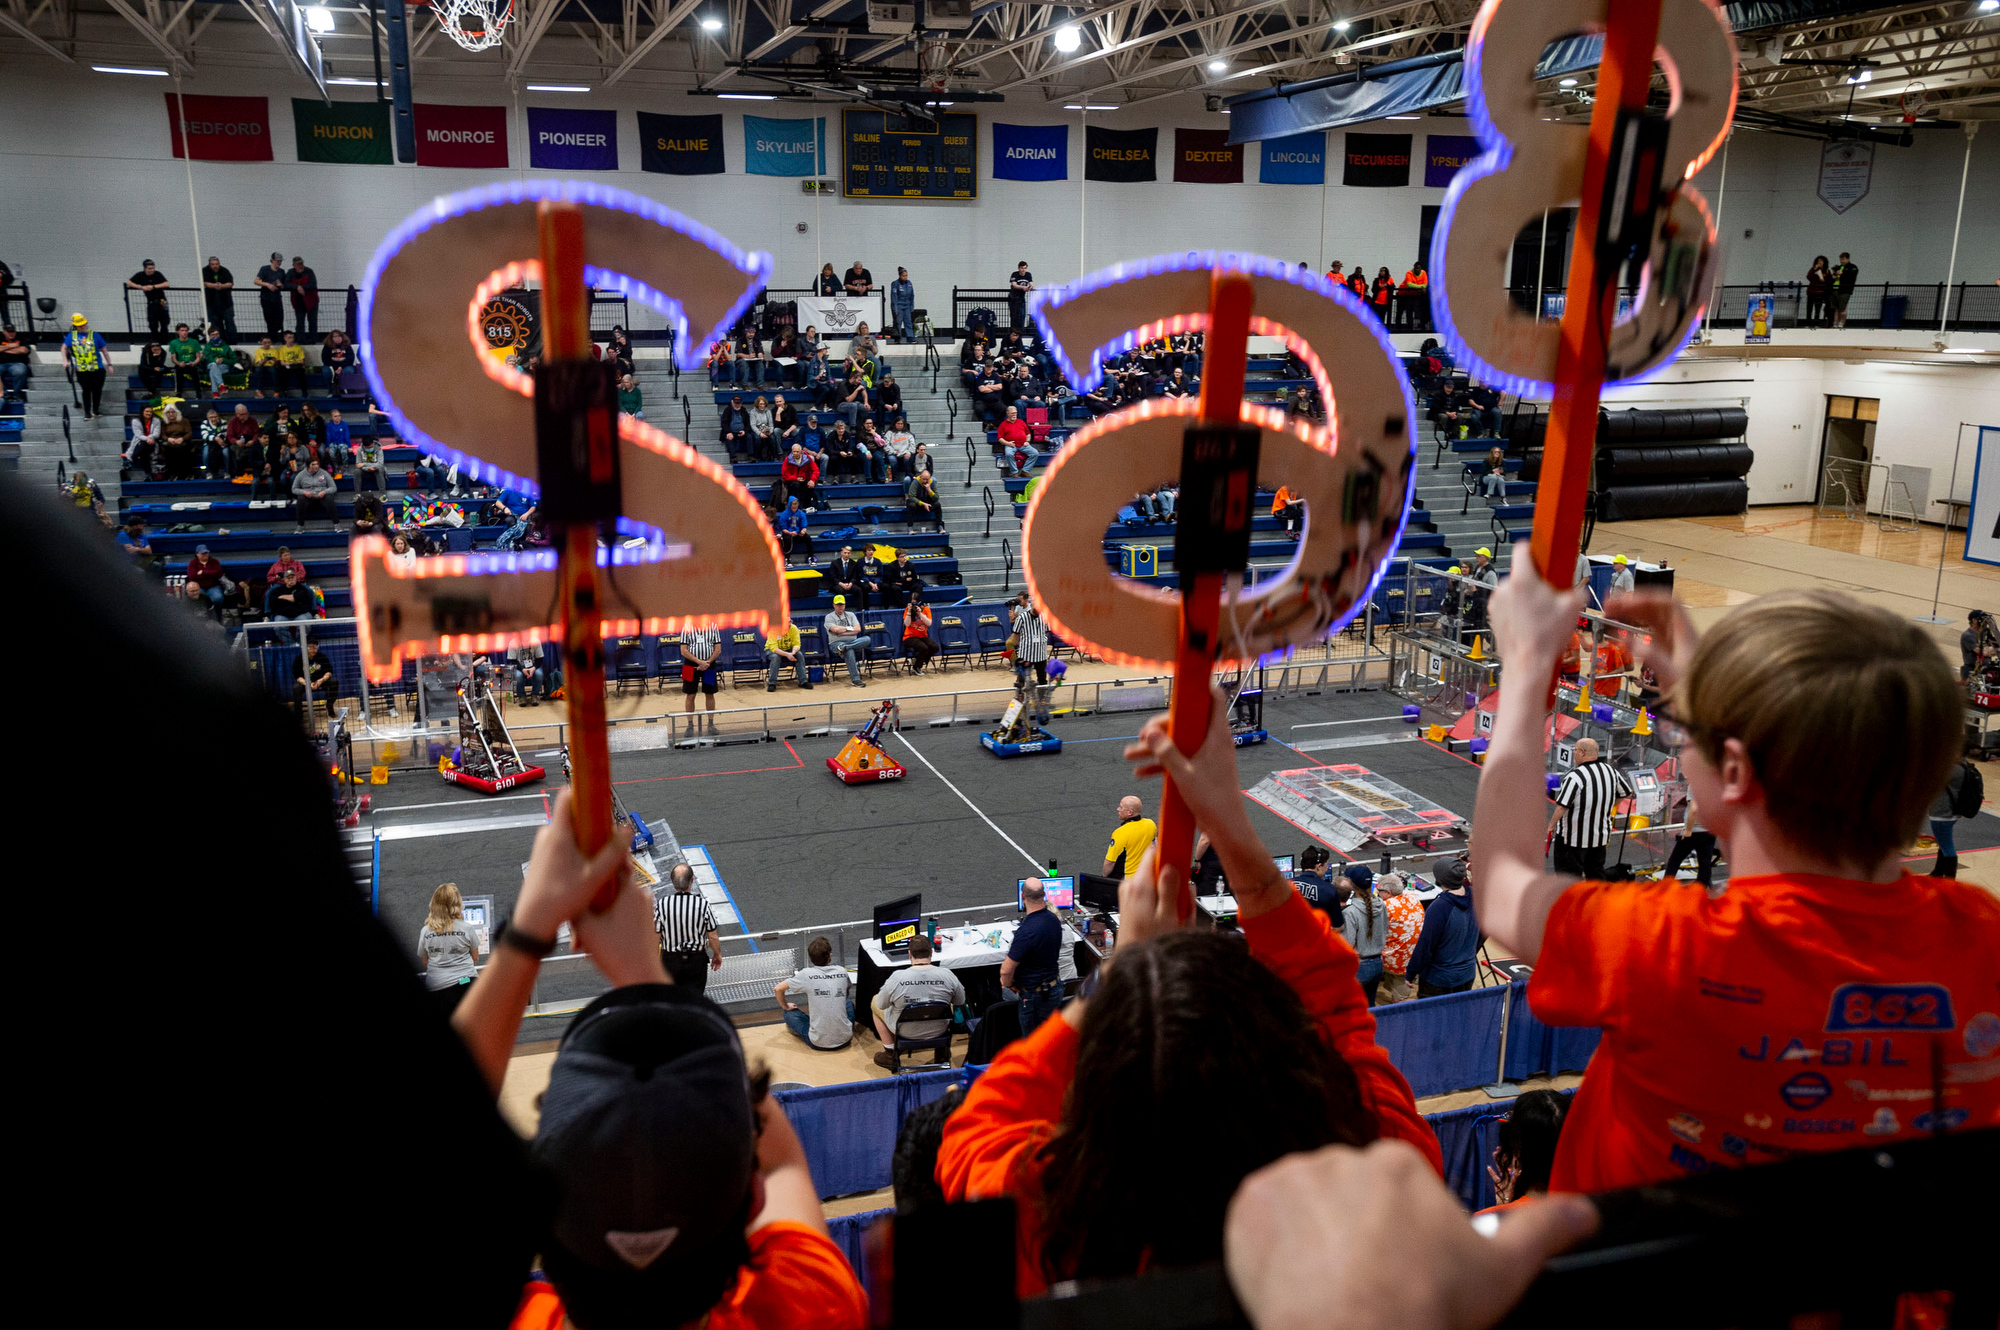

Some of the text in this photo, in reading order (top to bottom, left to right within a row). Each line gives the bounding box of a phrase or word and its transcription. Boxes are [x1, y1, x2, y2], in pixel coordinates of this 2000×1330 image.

[179, 121, 262, 136] BEDFORD
[313, 124, 374, 140] HURON
[426, 129, 495, 144] MONROE
[539, 131, 607, 147] PIONEER
[853, 133, 881, 143] SALINE
[902, 139, 921, 147] PERIOD
[944, 136, 969, 145] GUEST
[657, 138, 709, 151] SALINE
[756, 140, 815, 154] SKYLINE
[1006, 147, 1057, 160] ADRIAN
[1093, 148, 1150, 161] CHELSEA
[1185, 150, 1233, 163] DEXTER
[1270, 152, 1321, 164] LINCOLN
[1348, 154, 1409, 166] TECUMSEH
[1431, 156, 1482, 168] YPSILAN
[501, 296, 517, 305] THAN
[516, 302, 534, 322] ROBOTS
[488, 326, 512, 338] 815
[733, 633, 755, 643] SALINE
[1977, 695, 1988, 706] 74
[442, 770, 458, 783] 6101
[879, 769, 902, 779] 862
[495, 777, 516, 791] 6101
[886, 929, 907, 943] CHARGED
[1842, 992, 1940, 1026] 862
[1738, 1034, 1908, 1067] JABIL
[1782, 1118, 1856, 1134] BOSCH
